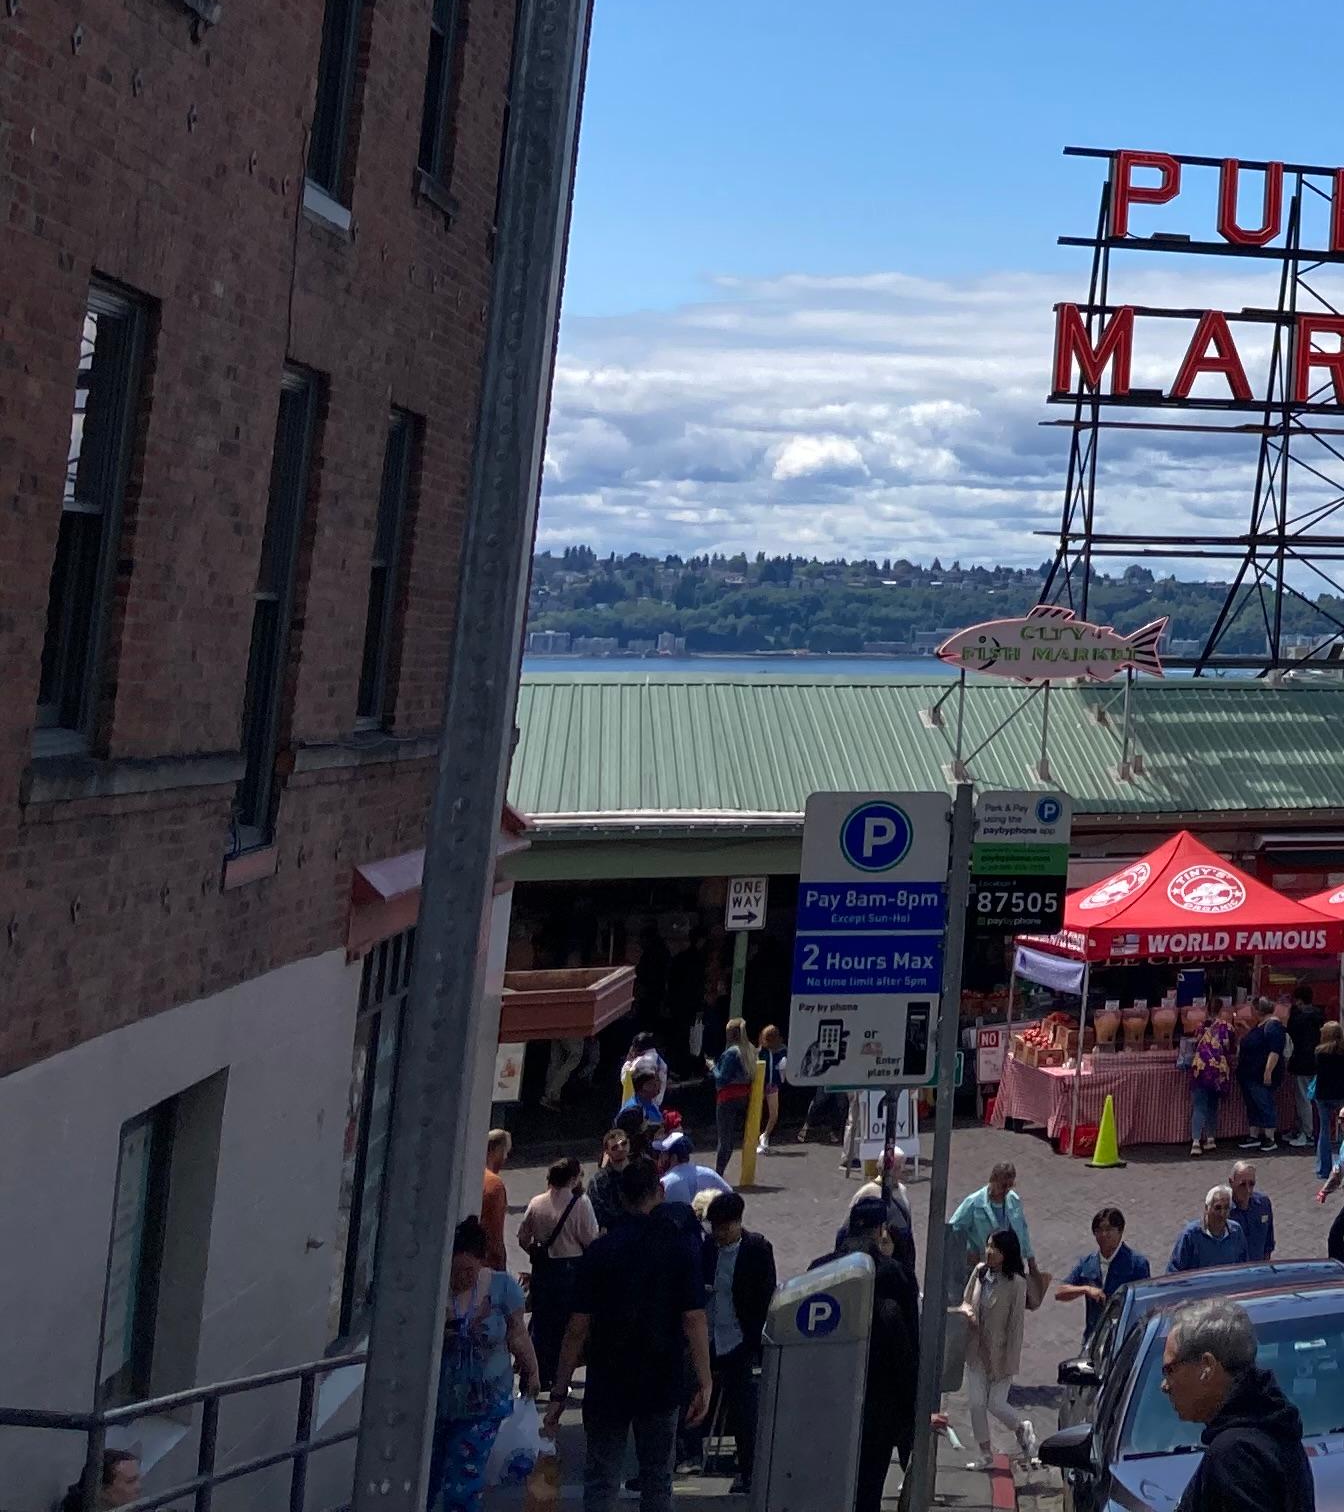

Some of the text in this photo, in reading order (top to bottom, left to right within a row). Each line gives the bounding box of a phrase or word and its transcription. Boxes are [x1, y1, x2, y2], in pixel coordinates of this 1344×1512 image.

[1021, 626, 1087, 641] CITY
[962, 646, 1137, 662] FISH MARKET
[984, 803, 1003, 812] Park
[1012, 803, 1029, 814] Pay
[1044, 803, 1056, 819] P
[862, 816, 897, 858] P
[983, 827, 1037, 836] paybyphone
[1176, 867, 1230, 885] TINY'S
[734, 881, 762, 894] ONE
[732, 895, 762, 908] WAY
[806, 890, 938, 912] Pay 8am-8pm
[977, 892, 1058, 913] 87505
[831, 913, 866, 925] Except
[1147, 929, 1327, 953] WORLD FAMOUS
[801, 943, 934, 971] 2 Hours Max
[807, 977, 821, 987] No
[823, 976, 847, 987] time
[849, 976, 875, 986] limit
[876, 975, 903, 986] after
[798, 1003, 858, 1014] Pay by phone
[864, 1030, 879, 1039] or
[981, 1032, 997, 1046] NO
[875, 1057, 901, 1065] Enter
[868, 1068, 891, 1077] plate
[872, 1121, 906, 1134] OY
[807, 1301, 832, 1331] P
